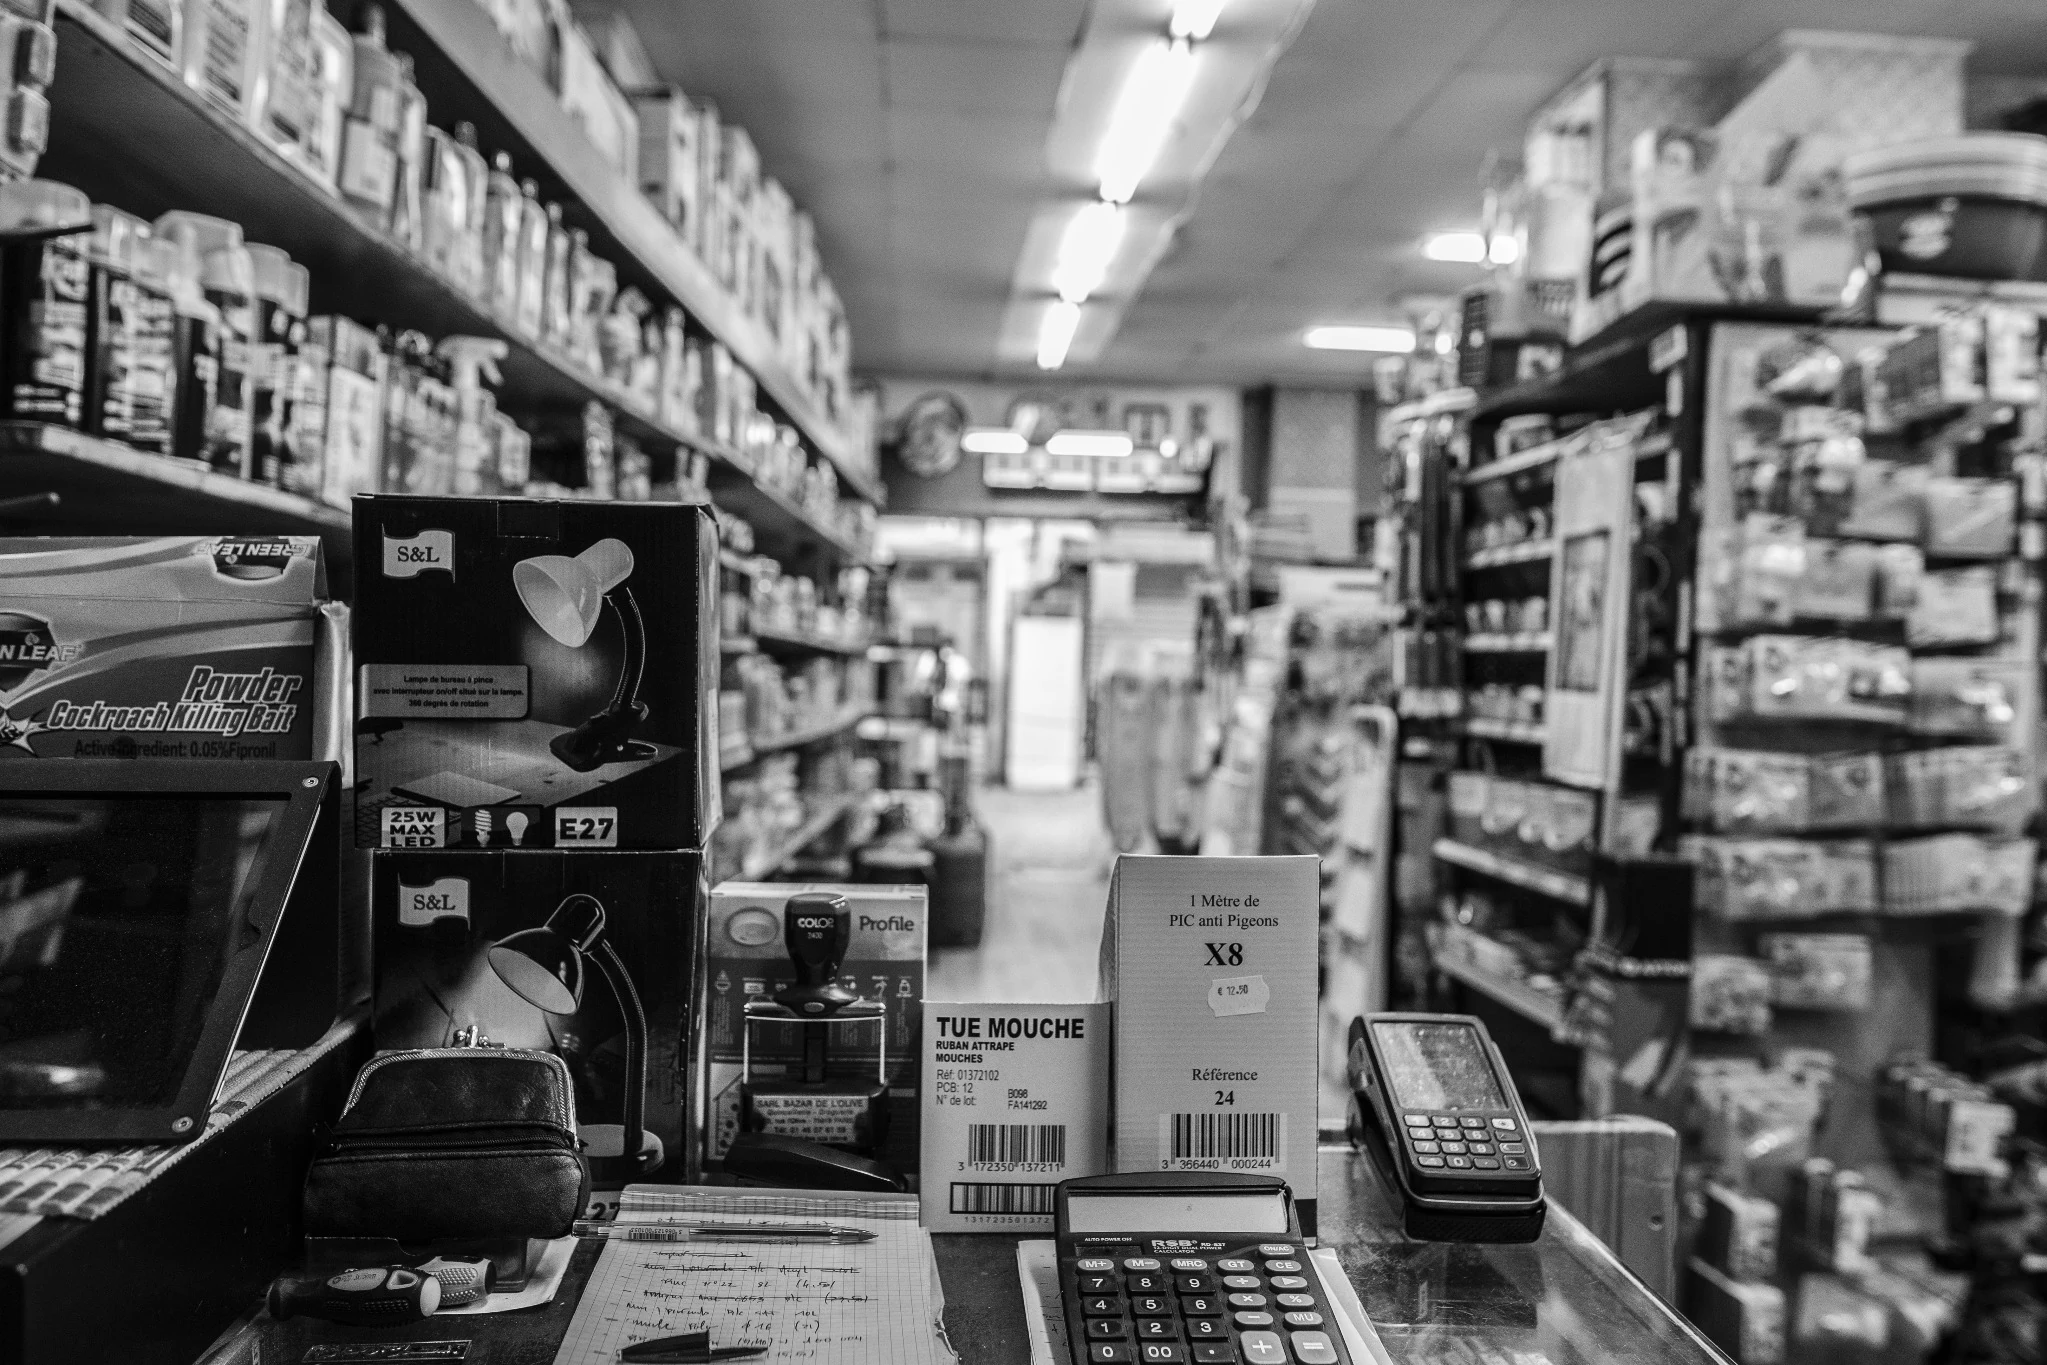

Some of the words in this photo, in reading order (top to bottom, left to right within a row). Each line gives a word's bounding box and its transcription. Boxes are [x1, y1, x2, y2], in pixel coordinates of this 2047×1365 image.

[396, 546, 441, 564] S&L
[16, 644, 78, 661] LEAF
[181, 665, 302, 704] Powder
[403, 675, 429, 684] Lampe
[430, 675, 439, 683] de
[467, 675, 472, 683] à
[474, 676, 493, 685] pince
[392, 688, 434, 697] interrupteur
[436, 687, 457, 696] on/off
[492, 688, 499, 696] la
[500, 688, 524, 697] lampe.
[409, 700, 422, 708] 360
[450, 700, 459, 708] de
[460, 700, 489, 708] rotation
[47, 700, 170, 731] Cockroach
[166, 702, 249, 737] Killing
[243, 704, 297, 733] Bait
[74, 739, 116, 757] Active
[391, 811, 436, 823] 25W
[390, 825, 436, 835] MAX
[559, 818, 614, 840] E27
[390, 837, 436, 847] LED
[413, 894, 456, 911] S&L
[1201, 894, 1240, 907] Mètre
[1244, 894, 1260, 907] de
[859, 915, 915, 932] Profile
[1169, 914, 1195, 927] PIC
[1198, 914, 1223, 927] anti
[1227, 914, 1279, 930] Pigeons
[1204, 942, 1244, 967] X8
[1217, 987, 1223, 996] €
[1226, 984, 1249, 995] 12.50
[936, 1017, 981, 1038] TUE
[988, 1018, 1085, 1039] MOUCHE
[936, 1041, 969, 1051] RUBAN
[971, 1042, 1015, 1051] ATTRAPE
[936, 1054, 983, 1063] MOUCHES
[936, 1069, 954, 1080] Réf:
[957, 1070, 999, 1081] 01372102
[1192, 1067, 1258, 1081] Référence
[936, 1082, 959, 1093] PCB:
[963, 1083, 973, 1093] 12
[783, 1099, 812, 1108] BAZAR
[815, 1099, 828, 1108] DE
[950, 1096, 961, 1106] de
[963, 1096, 977, 1106] lot:
[1214, 1090, 1235, 1106] 24
[1008, 1100, 1048, 1110] FA141292
[1440, 1117, 1450, 1126] 2
[1468, 1118, 1478, 1127] 3
[1444, 1130, 1454, 1138] 5
[1473, 1131, 1482, 1139] 6
[1422, 1143, 1431, 1152] 7
[1449, 1143, 1459, 1152] 8
[1477, 1144, 1486, 1153] 9
[958, 1162, 965, 1171] 3
[974, 1162, 1015, 1172] 172350
[1020, 1162, 1061, 1172] 137211
[1161, 1160, 1169, 1170] 3
[1179, 1159, 1220, 1170] 366440
[1231, 1159, 1271, 1169] 000244
[1085, 1259, 1108, 1269] M+
[1176, 1259, 1203, 1269] MRC
[1227, 1260, 1245, 1269] GT
[1275, 1261, 1294, 1270] CE
[1091, 1278, 1104, 1288] 7
[1140, 1278, 1152, 1288] 8
[1188, 1278, 1200, 1288] 9
[1095, 1299, 1107, 1310] 4
[1146, 1299, 1157, 1310] 5
[1195, 1299, 1207, 1310] 6
[1292, 1312, 1314, 1322] MU
[1101, 1322, 1109, 1333] 1
[1150, 1322, 1163, 1333] 2
[1200, 1322, 1212, 1333] 3
[1102, 1346, 1114, 1358] 0
[1147, 1346, 1172, 1358] 00
